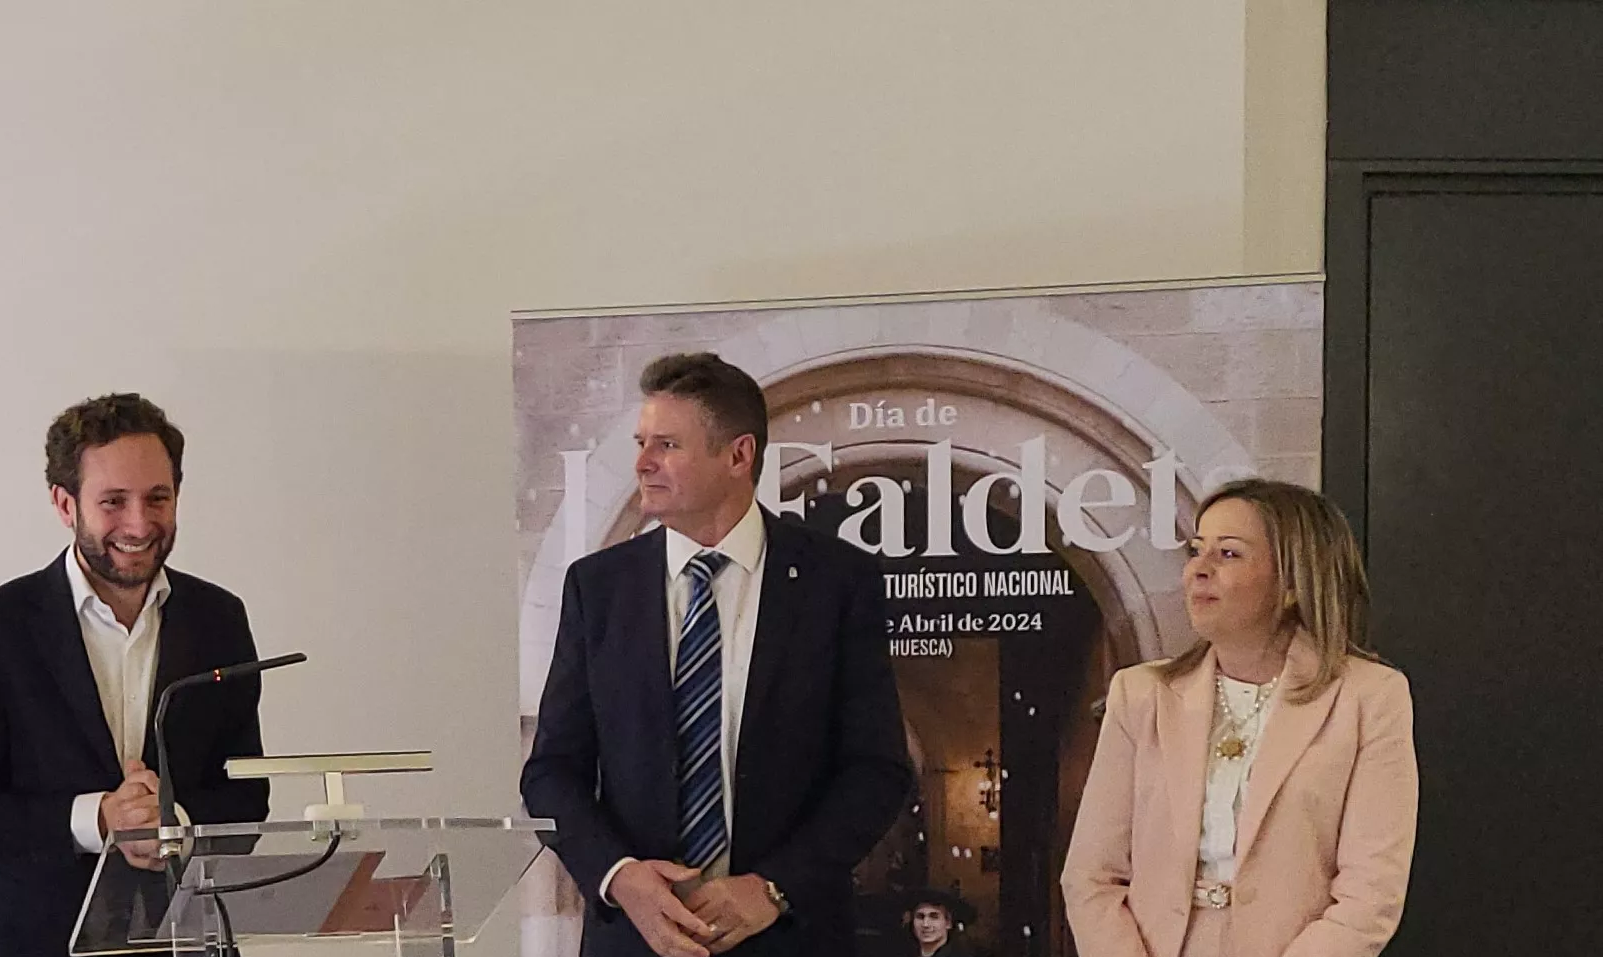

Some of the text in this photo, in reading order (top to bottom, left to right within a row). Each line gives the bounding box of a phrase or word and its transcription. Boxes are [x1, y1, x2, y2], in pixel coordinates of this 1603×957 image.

[849, 398, 957, 430] Día de
[756, 434, 1257, 557] Faldet
[883, 567, 1074, 599] TURÍSTICO NACIONAL
[899, 613, 954, 633] Abril
[957, 613, 984, 632] de
[987, 612, 1043, 631] 2024
